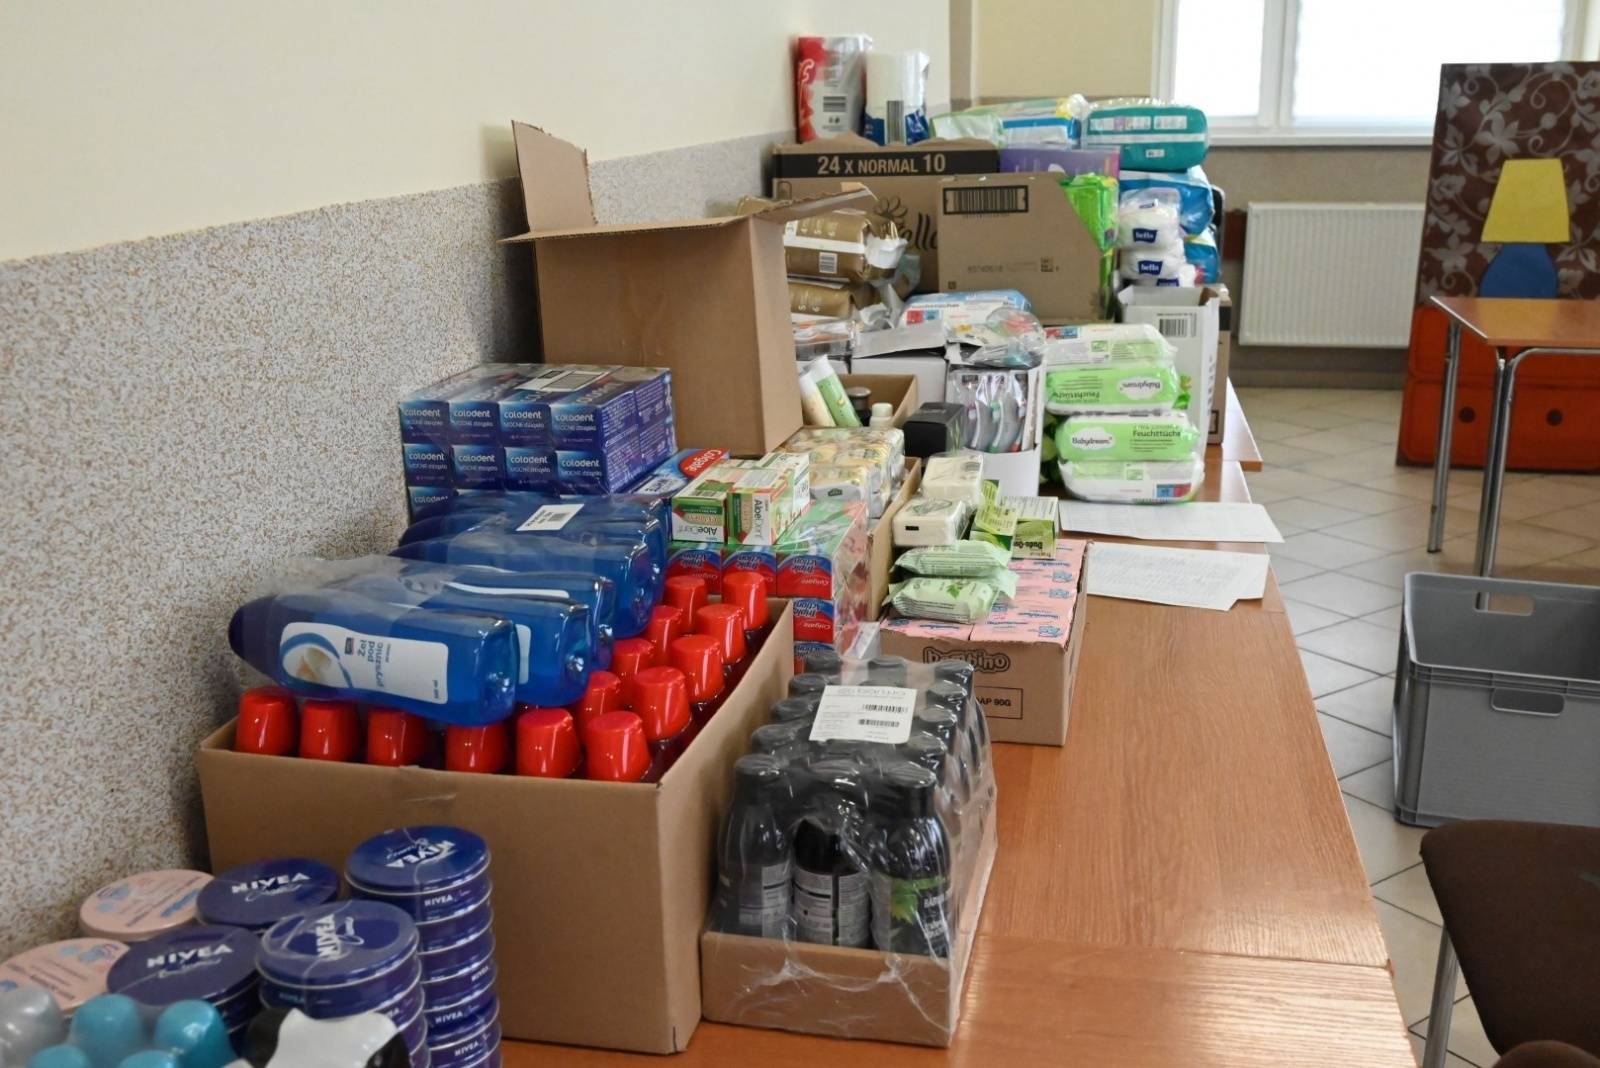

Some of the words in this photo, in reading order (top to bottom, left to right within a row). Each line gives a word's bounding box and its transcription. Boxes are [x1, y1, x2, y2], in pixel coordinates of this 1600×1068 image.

[818, 156, 840, 174] 24
[858, 158, 918, 174] NORMAL
[923, 154, 946, 172] 10
[1136, 230, 1154, 238] bella
[1122, 381, 1160, 390] Babydream
[404, 408, 440, 417] colodent
[454, 409, 490, 418] colodent
[504, 410, 541, 419] colodent
[555, 413, 594, 422] colodent
[1072, 437, 1110, 446] Babydream
[409, 452, 444, 461] colodent
[458, 454, 495, 462] colodent
[510, 455, 548, 464] colodent
[686, 450, 722, 472] Colgate
[562, 459, 599, 468] colodent
[754, 499, 763, 539] AloeDent
[678, 525, 717, 535] AloeDent
[683, 553, 712, 561] Action
[739, 554, 766, 563] Action
[737, 561, 760, 570] Triple
[792, 558, 822, 566] Action
[791, 565, 815, 573] Triple
[794, 602, 824, 610] Action
[793, 609, 817, 617] Triple
[358, 640, 367, 658] Żel
[375, 643, 384, 688] prysznic
[386, 840, 455, 868] NIVEA
[232, 872, 310, 893] NIVEA
[424, 894, 453, 906] NIVEA
[316, 914, 341, 957] NIVEA
[146, 944, 234, 968] NIVEA
[435, 1011, 463, 1024] NIVEA
[455, 1041, 479, 1056] NIVEA
